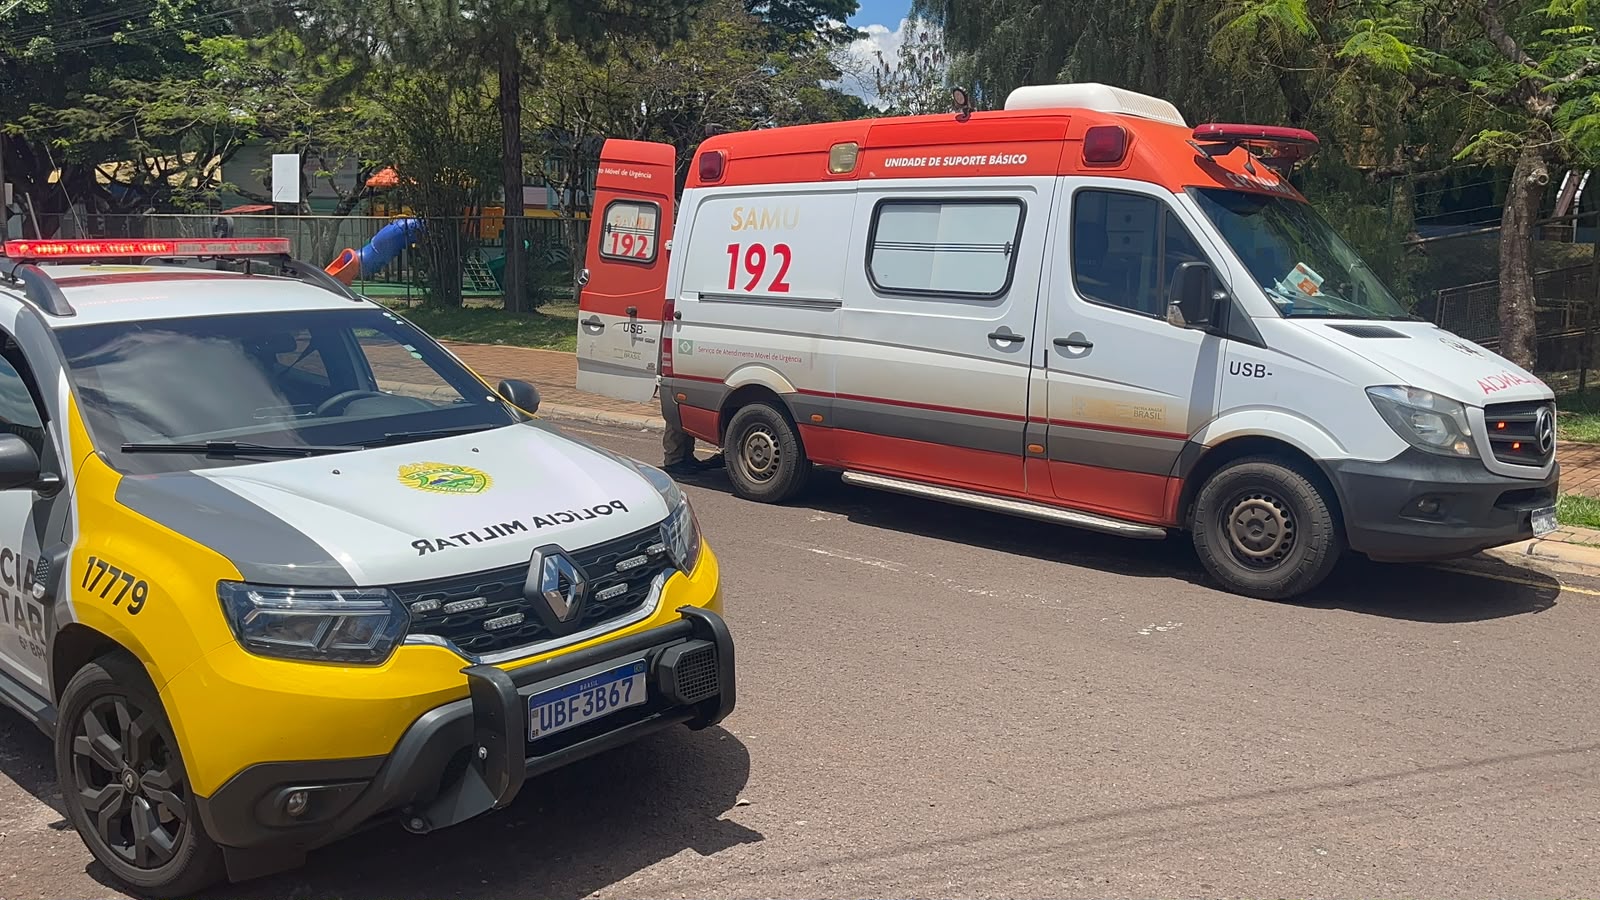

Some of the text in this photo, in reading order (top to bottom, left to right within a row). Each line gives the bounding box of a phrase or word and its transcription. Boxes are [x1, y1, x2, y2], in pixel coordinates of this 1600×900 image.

[885, 152, 1027, 167] UNIDADE DE SUPORTE BÁSICO
[730, 206, 800, 231] SAMU
[612, 233, 648, 258] 192
[726, 243, 792, 293] 192
[623, 322, 647, 335] USB-
[698, 346, 715, 355] Serviço
[723, 349, 754, 359] Atendimento
[771, 352, 779, 360] de
[1230, 361, 1273, 378] USB-
[1133, 410, 1162, 420] BRASIL
[82, 556, 149, 615] 17779
[580, 680, 599, 691] BRASIL
[540, 677, 634, 731] UBF3B67
